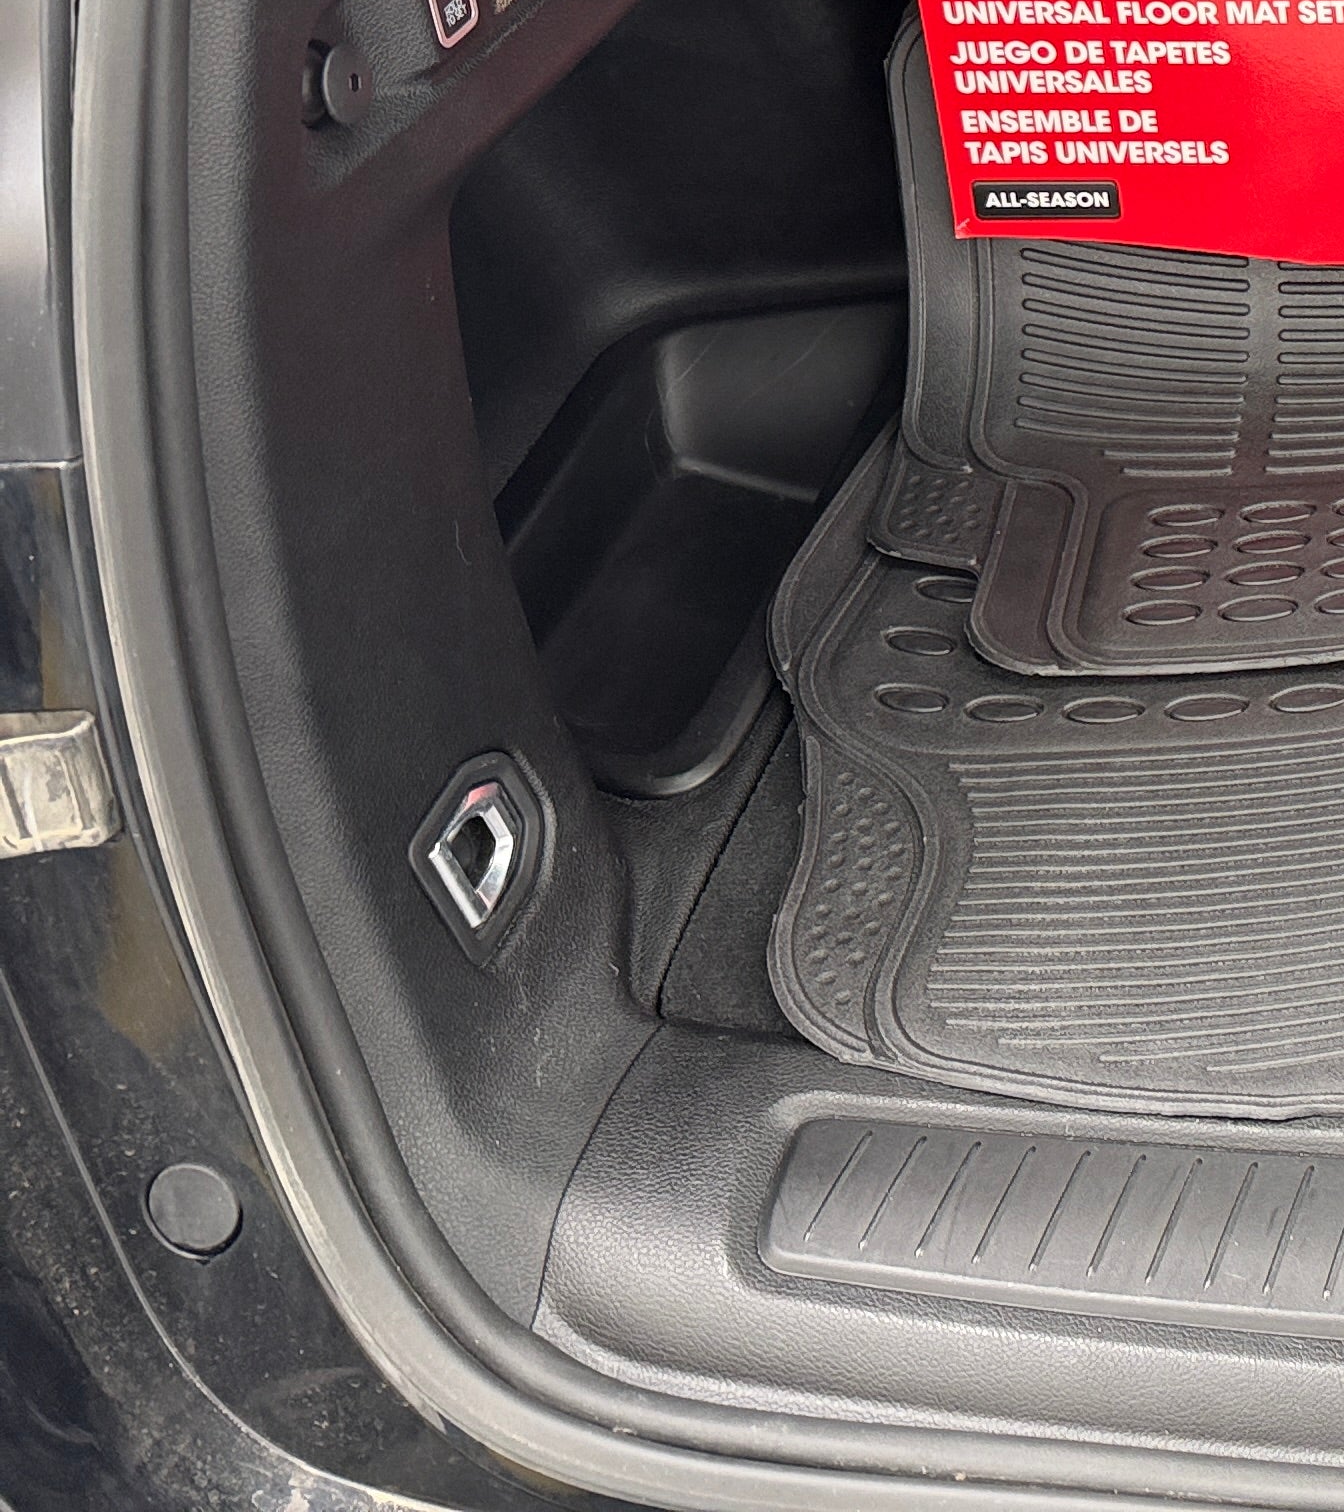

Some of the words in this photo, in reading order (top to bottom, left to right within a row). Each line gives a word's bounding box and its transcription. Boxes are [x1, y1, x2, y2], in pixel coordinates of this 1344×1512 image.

[942, 0, 1111, 25] UNIVERSAL
[1118, 0, 1219, 25] FLOOR
[1225, 0, 1290, 24] MAT
[950, 40, 1057, 65] JUEGO
[1065, 40, 1105, 65] DE
[1110, 40, 1231, 65] TAPETES
[954, 70, 1152, 94] UNIVERSALES
[960, 109, 1112, 133] ENSEMBLE
[1118, 109, 1158, 133] DE
[963, 140, 1048, 165] TAPIS
[1056, 140, 1229, 165] UNIVERSELS
[985, 192, 1110, 209] ALL-SEASON
